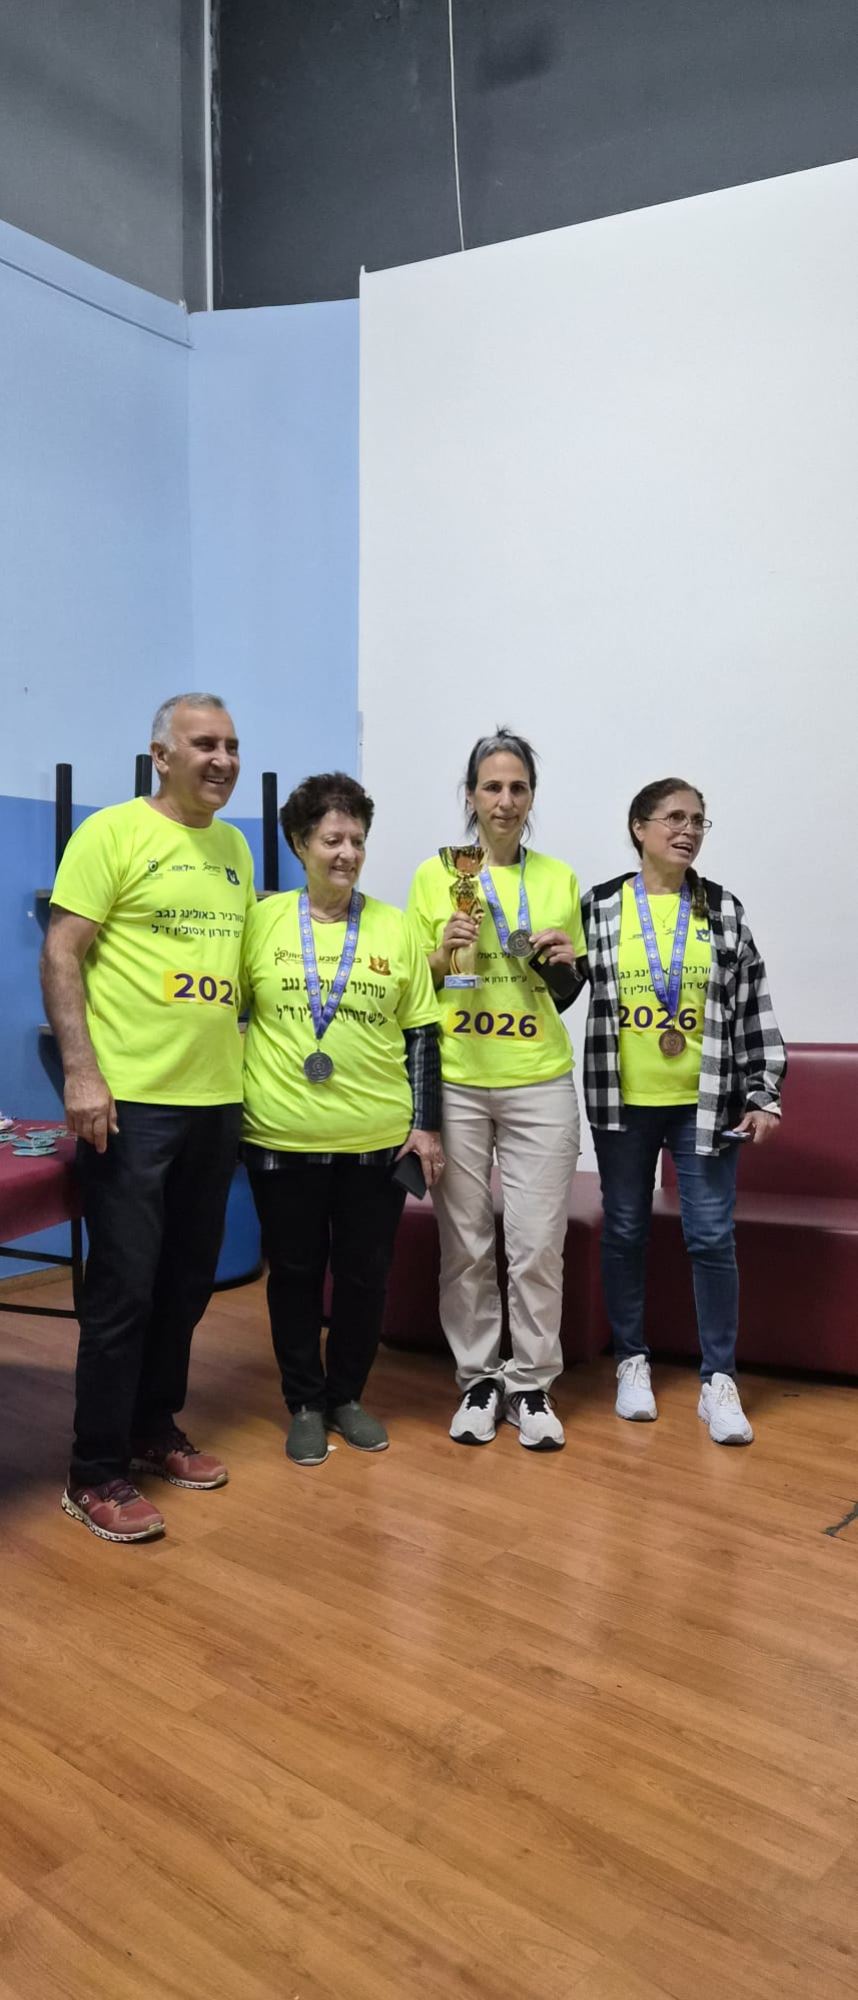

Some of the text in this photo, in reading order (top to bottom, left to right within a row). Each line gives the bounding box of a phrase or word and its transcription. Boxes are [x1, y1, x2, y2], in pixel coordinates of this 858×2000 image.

[155, 908, 244, 923] טורניר באולינג נגב
[151, 924, 170, 934] ז"ל
[174, 925, 206, 936] אסולין
[208, 928, 231, 938] דורון
[619, 971, 631, 980] נג
[281, 977, 300, 991] נגב
[350, 980, 386, 999] טורניר
[629, 984, 656, 995] סולין
[339, 1007, 367, 1024] דורון
[618, 1004, 697, 1031] 2026
[453, 1010, 537, 1038] 2026
